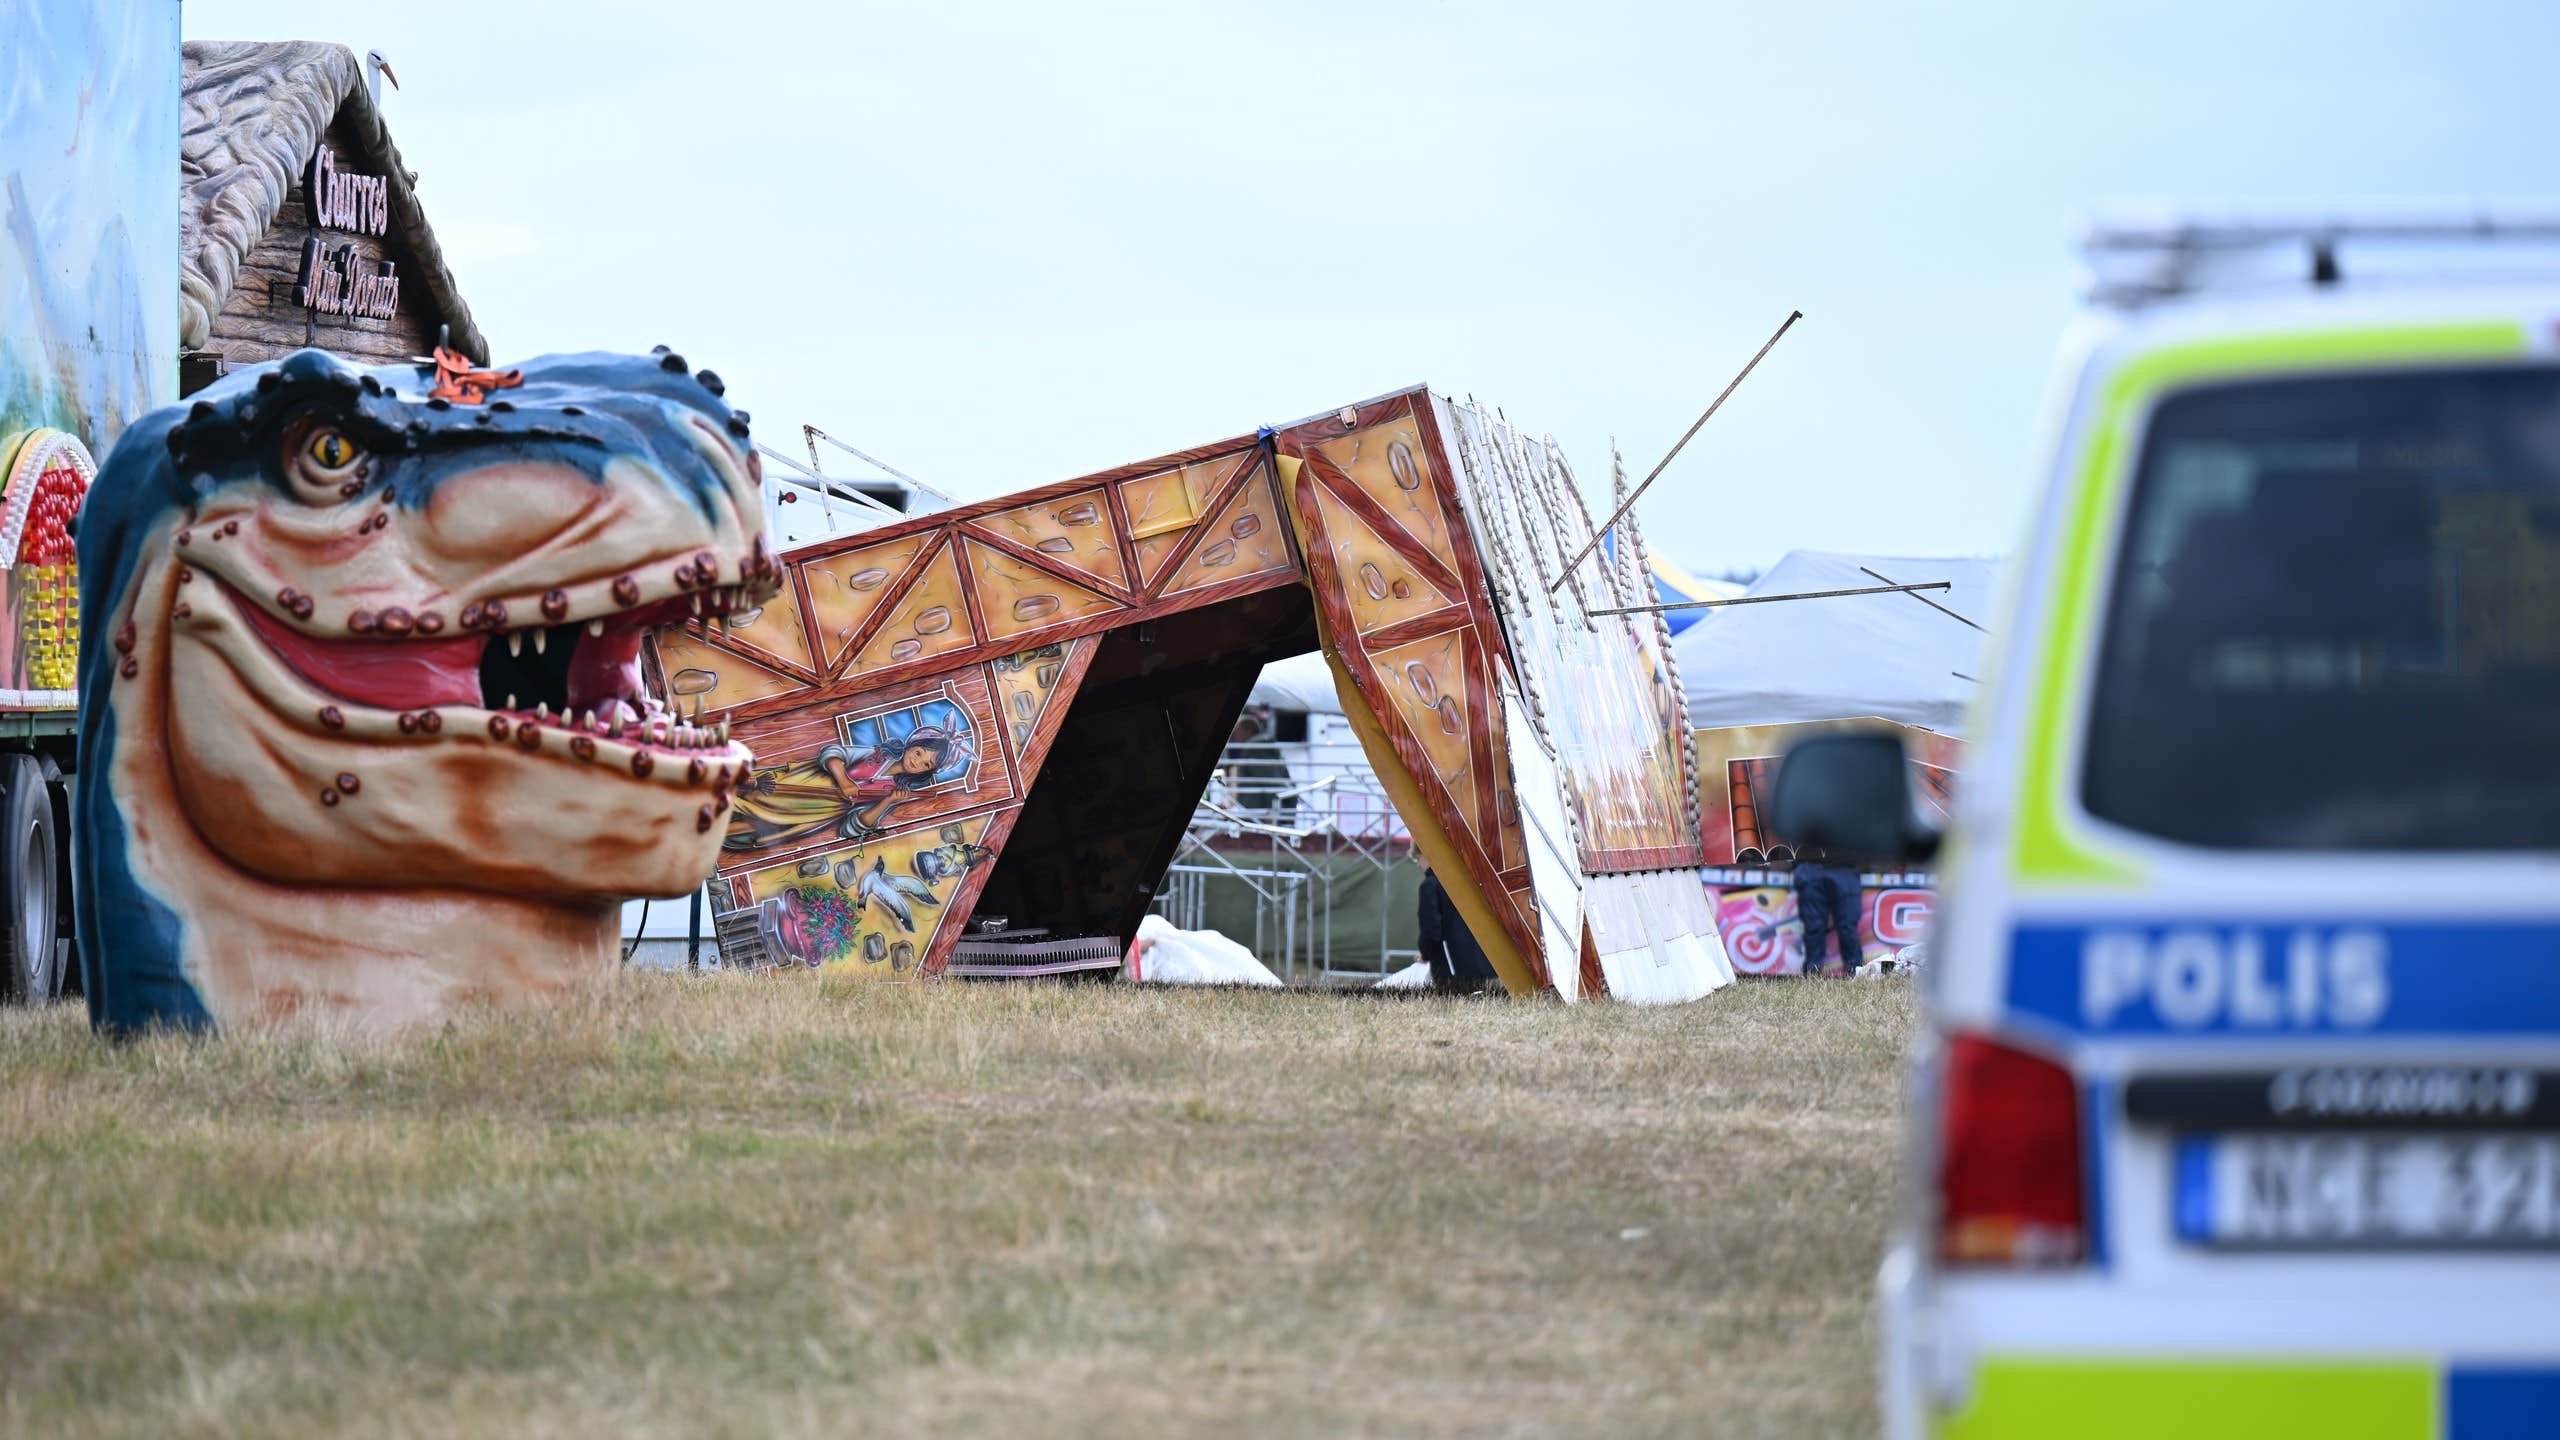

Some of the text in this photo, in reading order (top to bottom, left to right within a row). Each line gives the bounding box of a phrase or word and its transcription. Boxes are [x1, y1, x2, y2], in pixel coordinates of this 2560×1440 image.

[314, 143, 388, 236] Churros
[341, 244, 399, 320] Donuts
[2083, 928, 2390, 1030] POLIS
